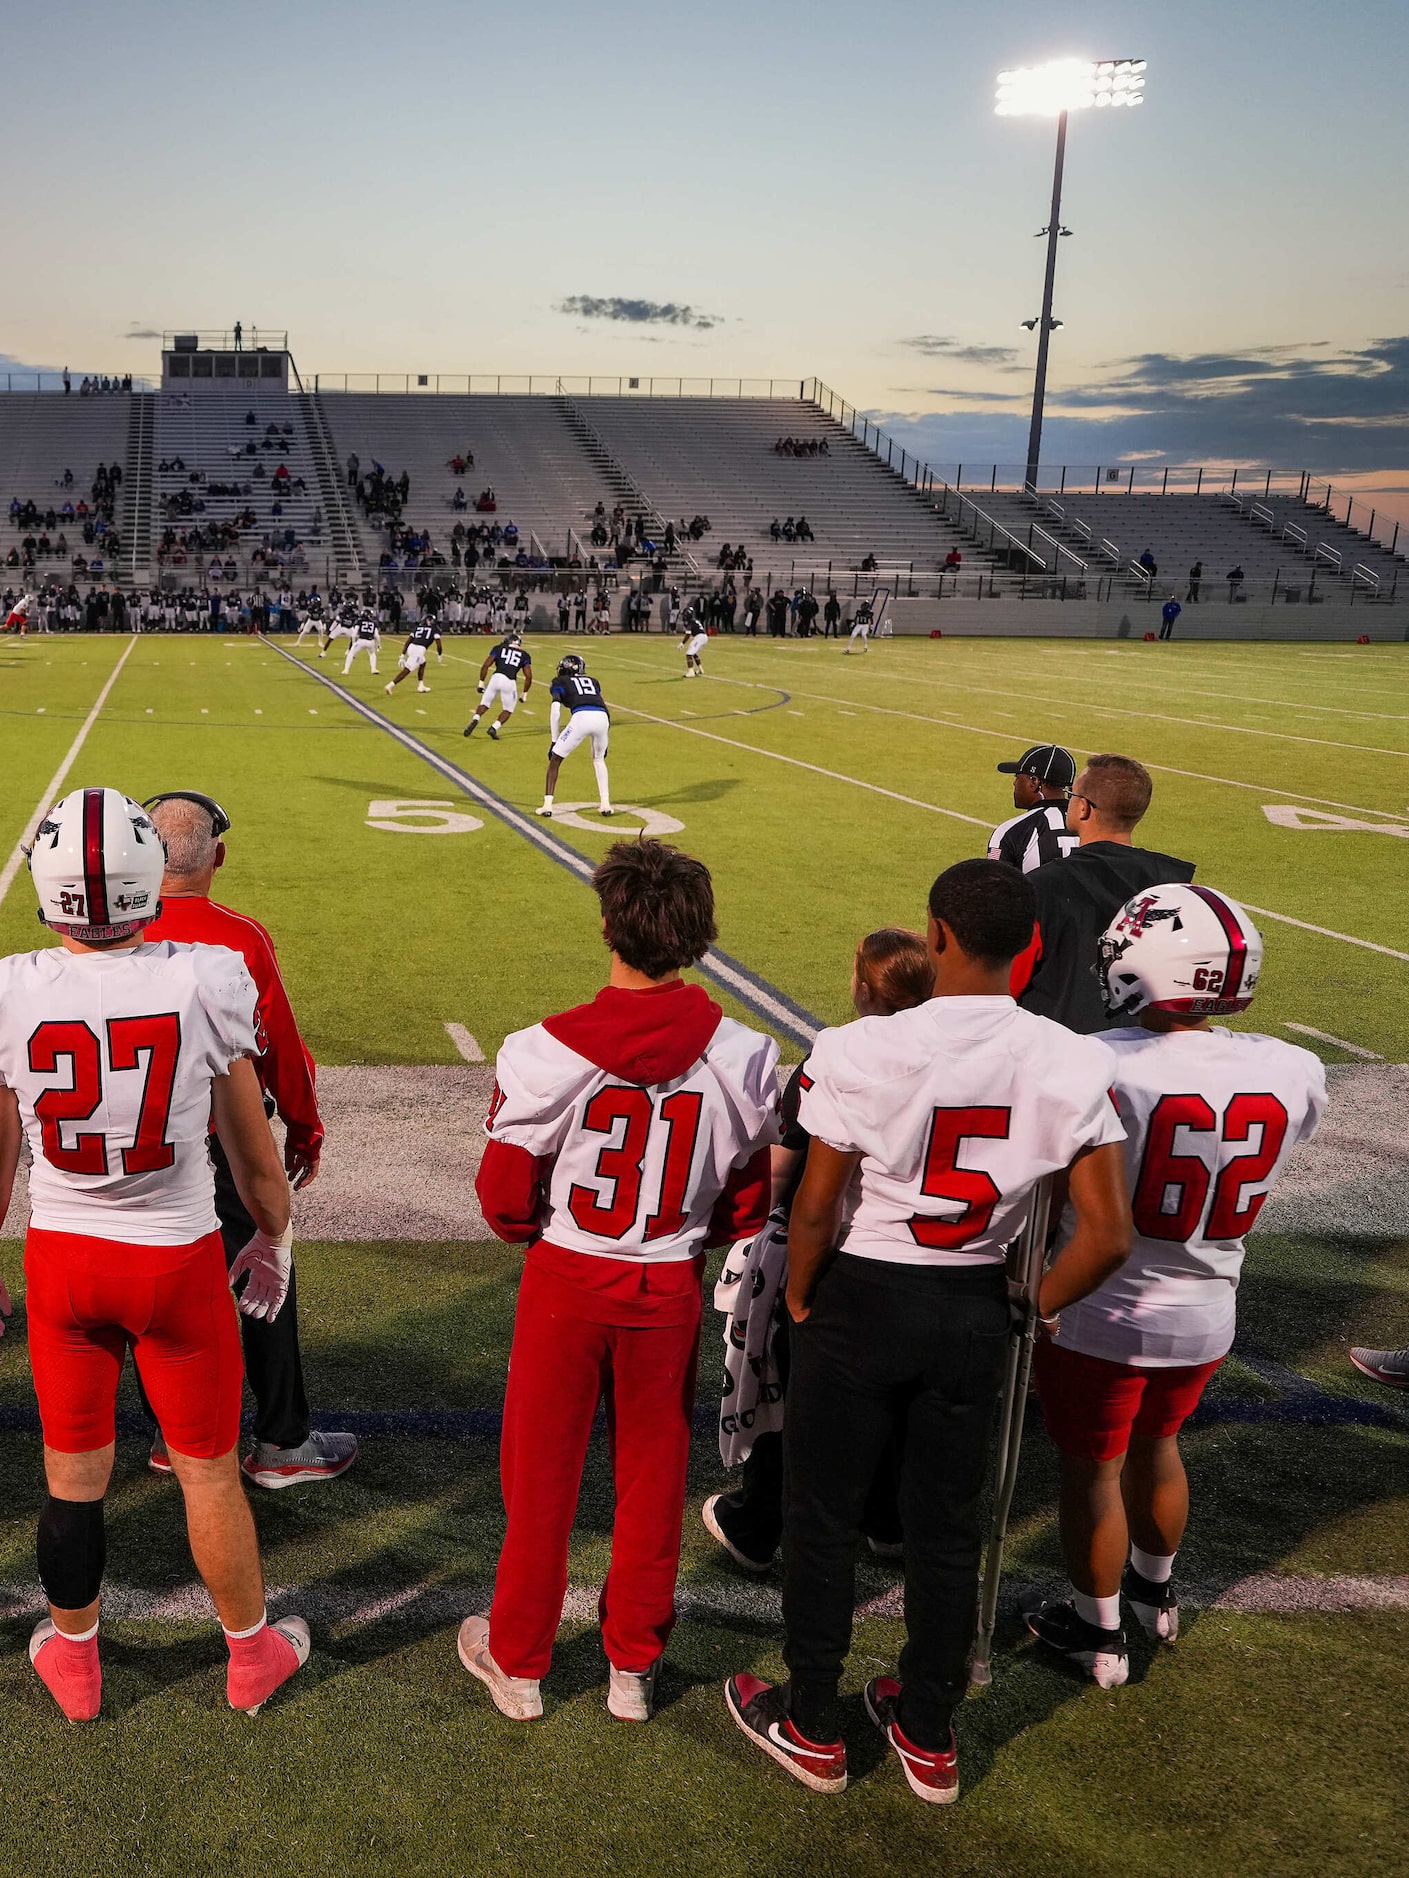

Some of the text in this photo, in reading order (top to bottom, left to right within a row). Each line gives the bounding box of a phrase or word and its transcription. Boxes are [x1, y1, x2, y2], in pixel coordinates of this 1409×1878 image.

[1109, 471, 1116, 480] G
[361, 621, 375, 634] 23
[414, 627, 432, 640] 27
[500, 647, 523, 667] 46
[570, 676, 597, 696] 19
[60, 891, 85, 917] 27
[68, 923, 133, 940] EAGLES
[1192, 967, 1224, 994] 62
[26, 1010, 182, 1177] 27
[567, 1084, 704, 1244] 31
[1131, 1092, 1290, 1244] 62
[907, 1105, 1013, 1251] 5
